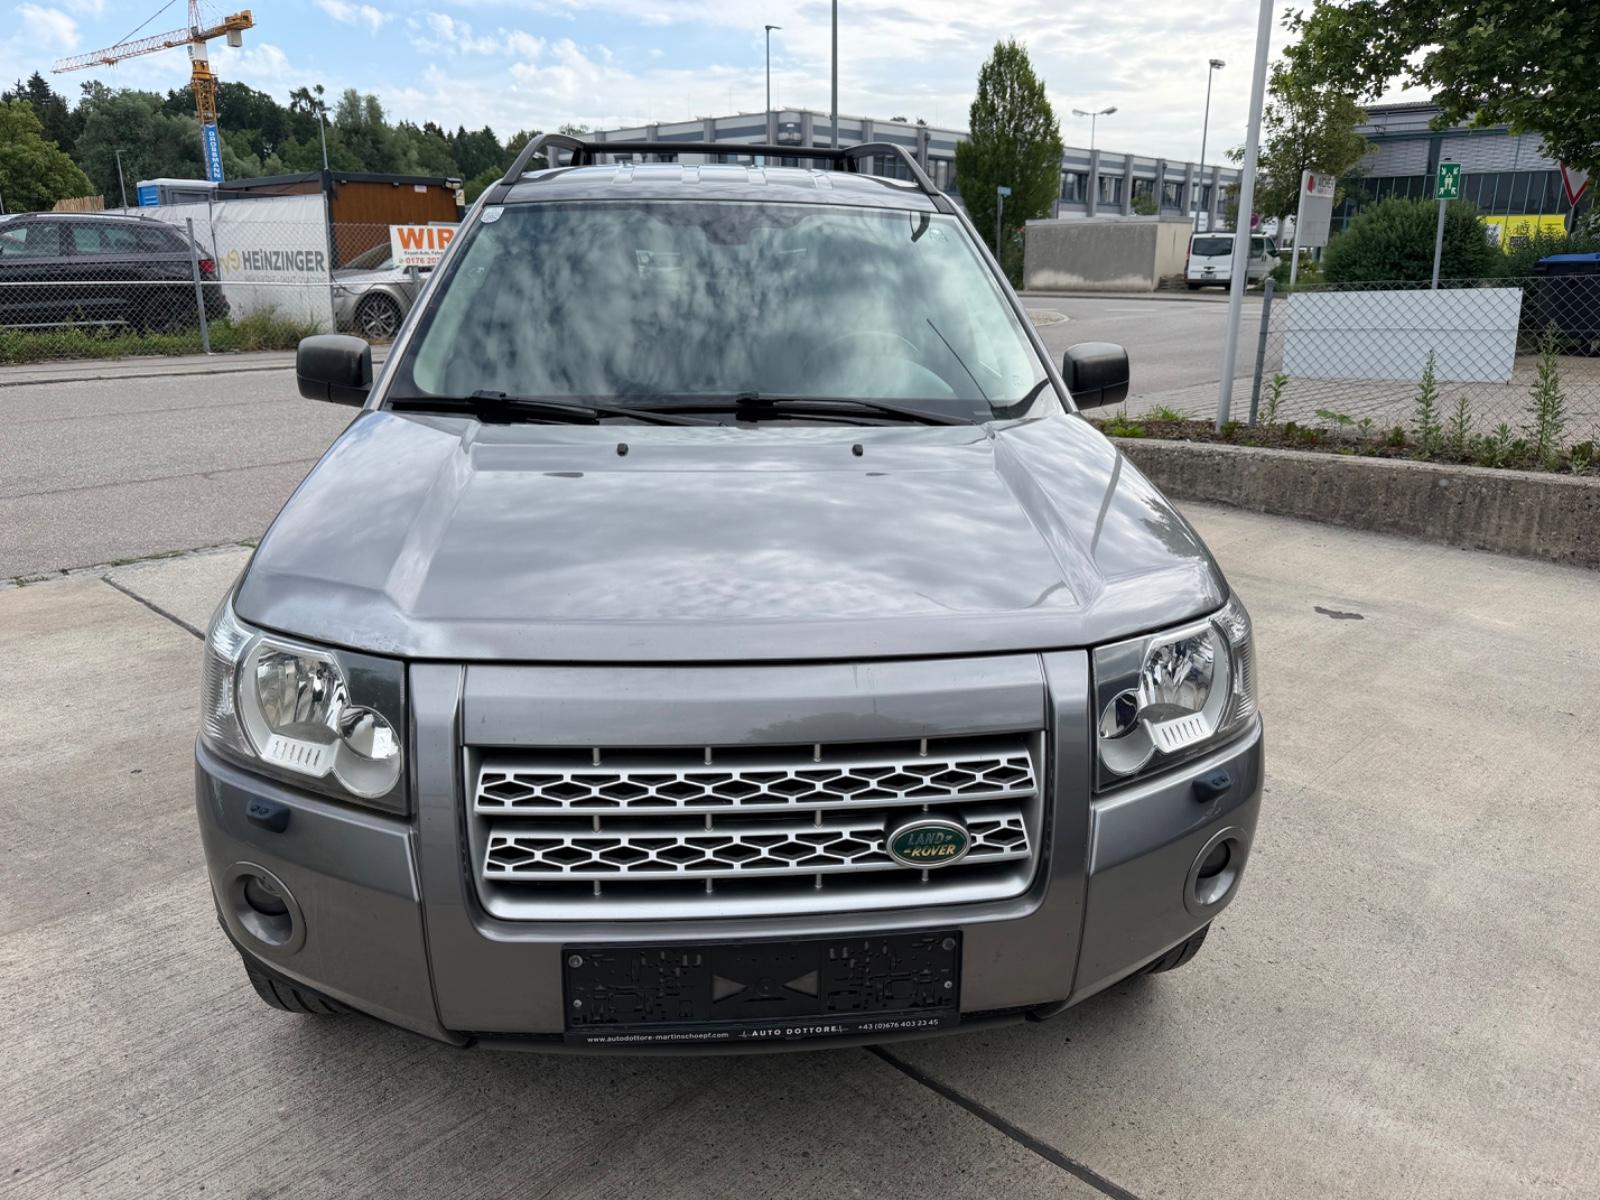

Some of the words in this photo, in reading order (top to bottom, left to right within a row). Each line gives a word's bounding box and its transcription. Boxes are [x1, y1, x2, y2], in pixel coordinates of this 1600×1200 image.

[396, 227, 454, 250] WIR
[907, 831, 945, 846] LAND
[911, 844, 957, 857] ROVER
[751, 1029, 782, 1037] AUTO
[786, 1025, 837, 1035] DOTTORE
[858, 1023, 873, 1031] +43
[900, 1020, 916, 1028] 403
